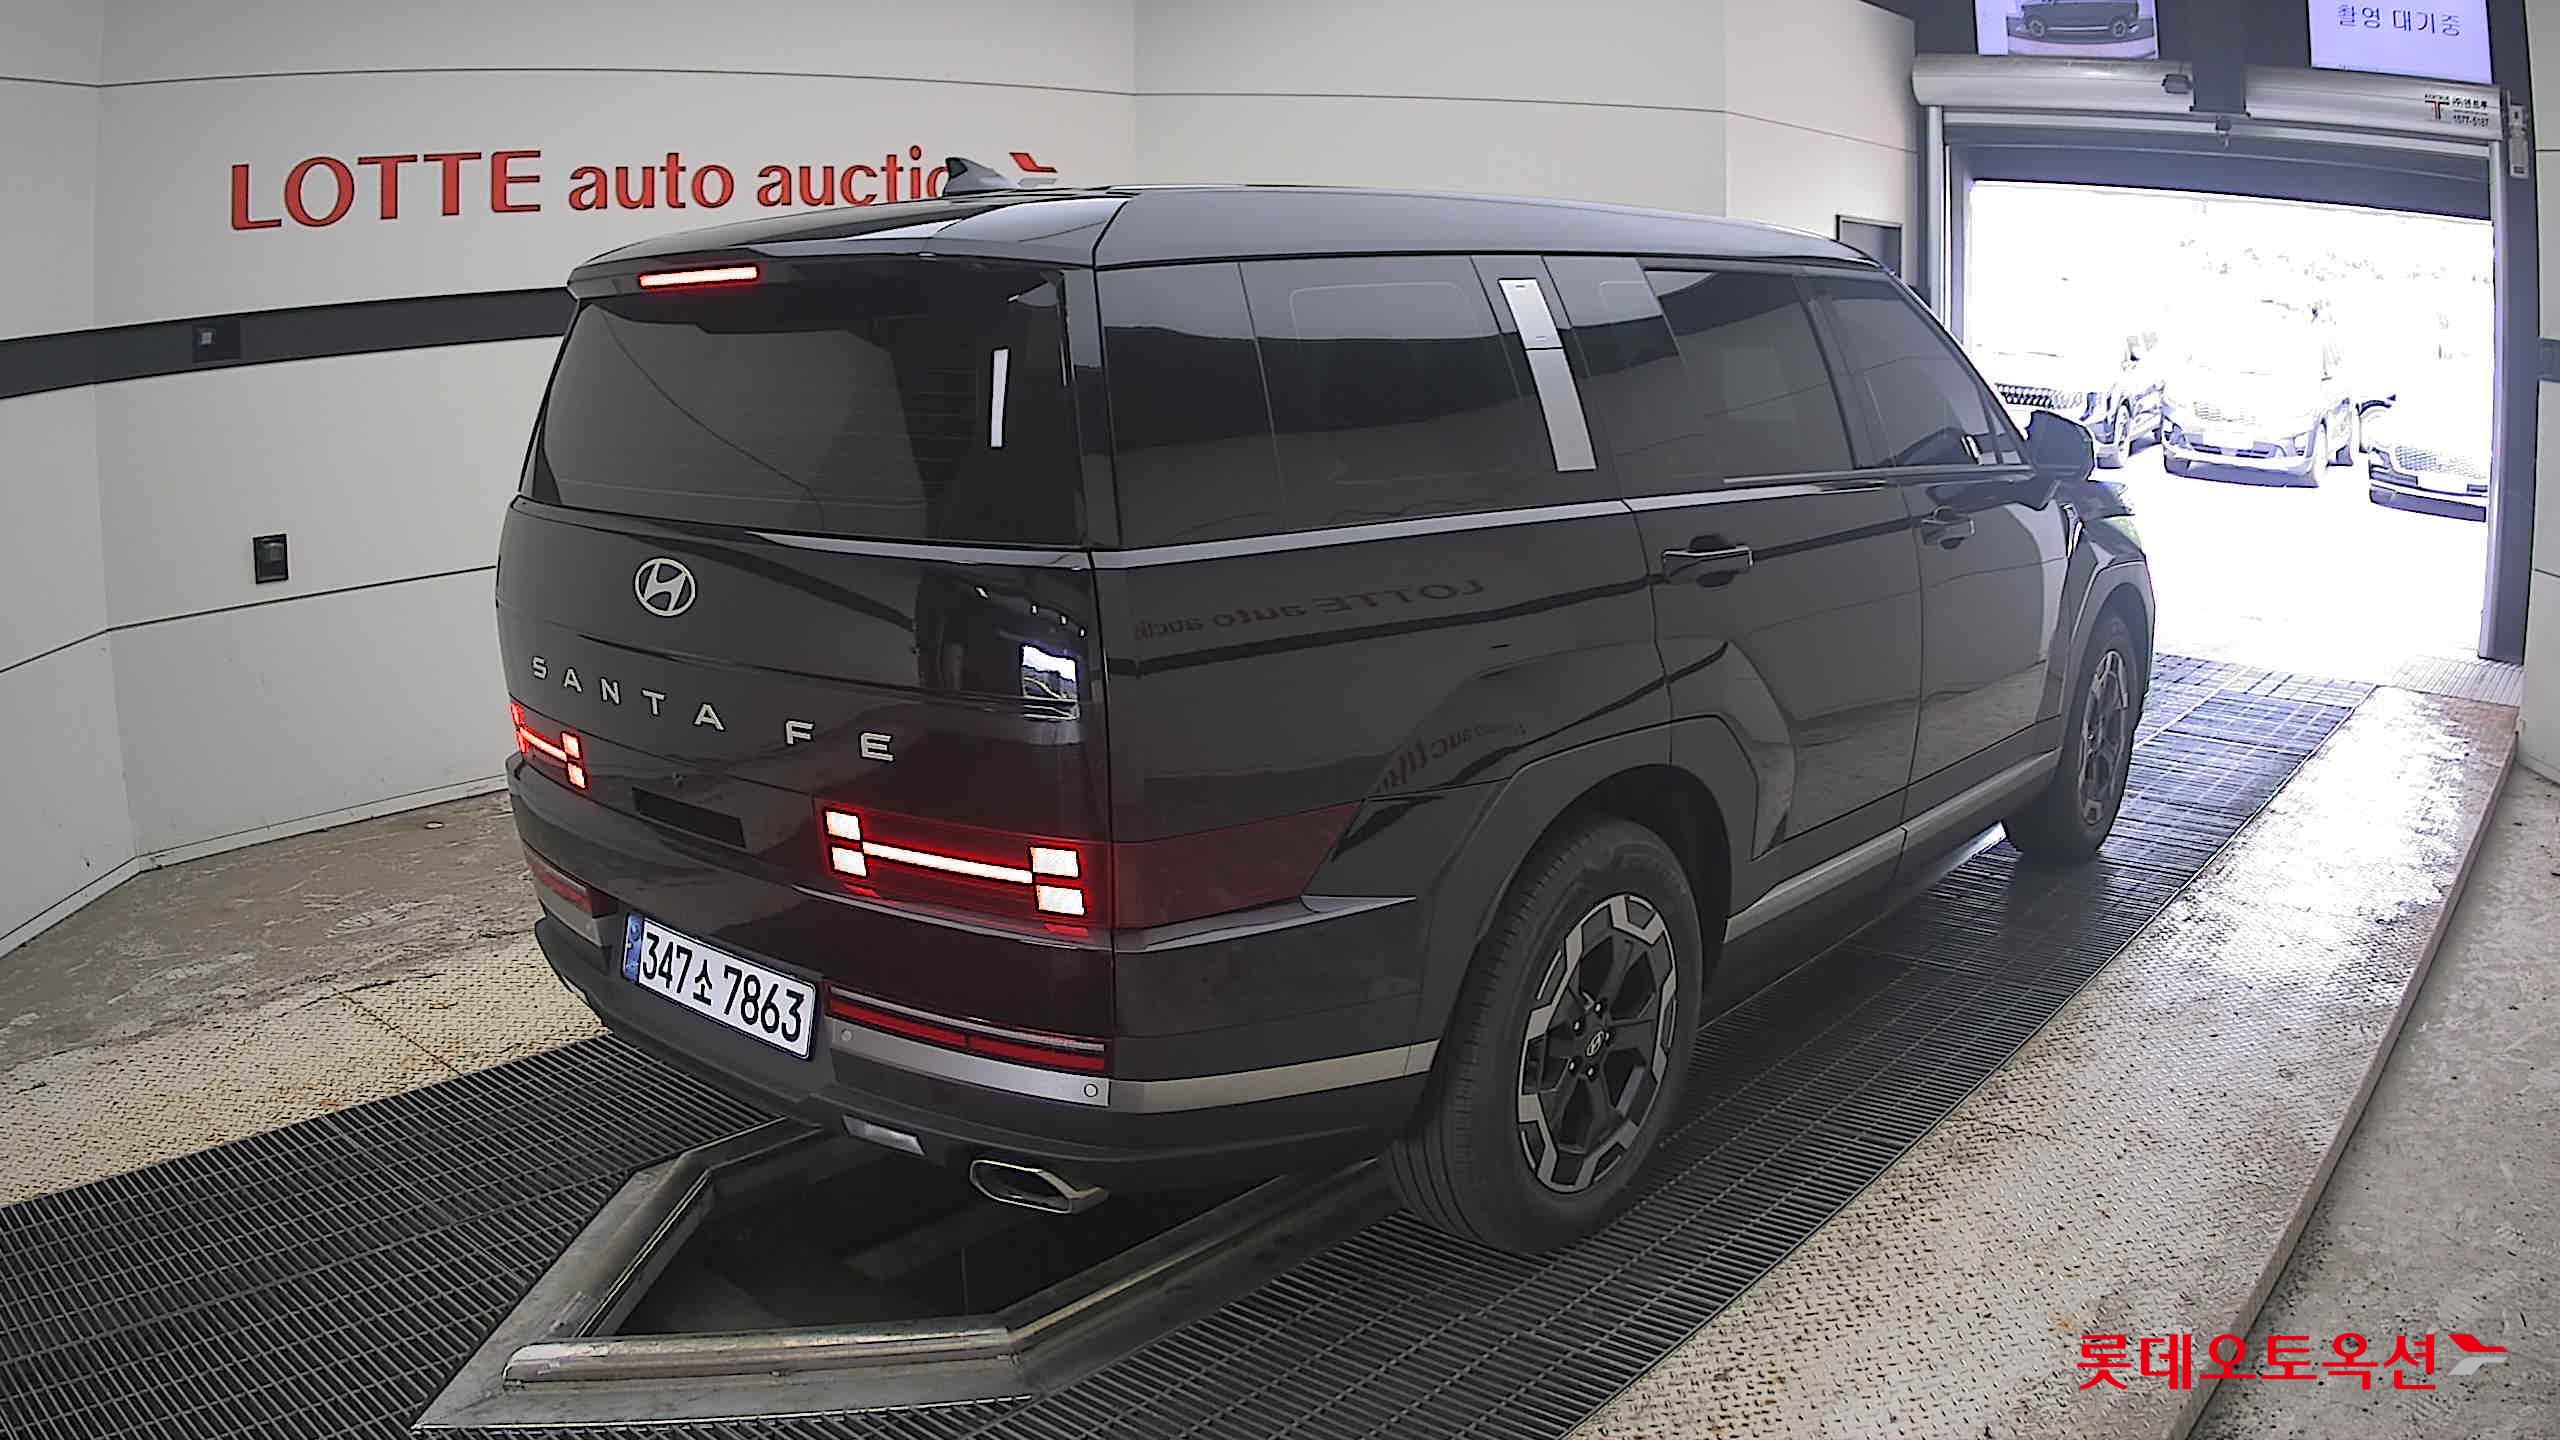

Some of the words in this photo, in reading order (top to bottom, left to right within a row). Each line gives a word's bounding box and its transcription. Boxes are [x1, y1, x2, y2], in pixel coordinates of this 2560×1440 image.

[2392, 9, 2460, 37] 대기중
[231, 149, 541, 231] LOTTE
[568, 152, 736, 210] auto
[530, 655, 725, 731] SANTA
[785, 720, 895, 762] FE
[642, 931, 713, 1007] 347소
[723, 963, 805, 1043] 7863
